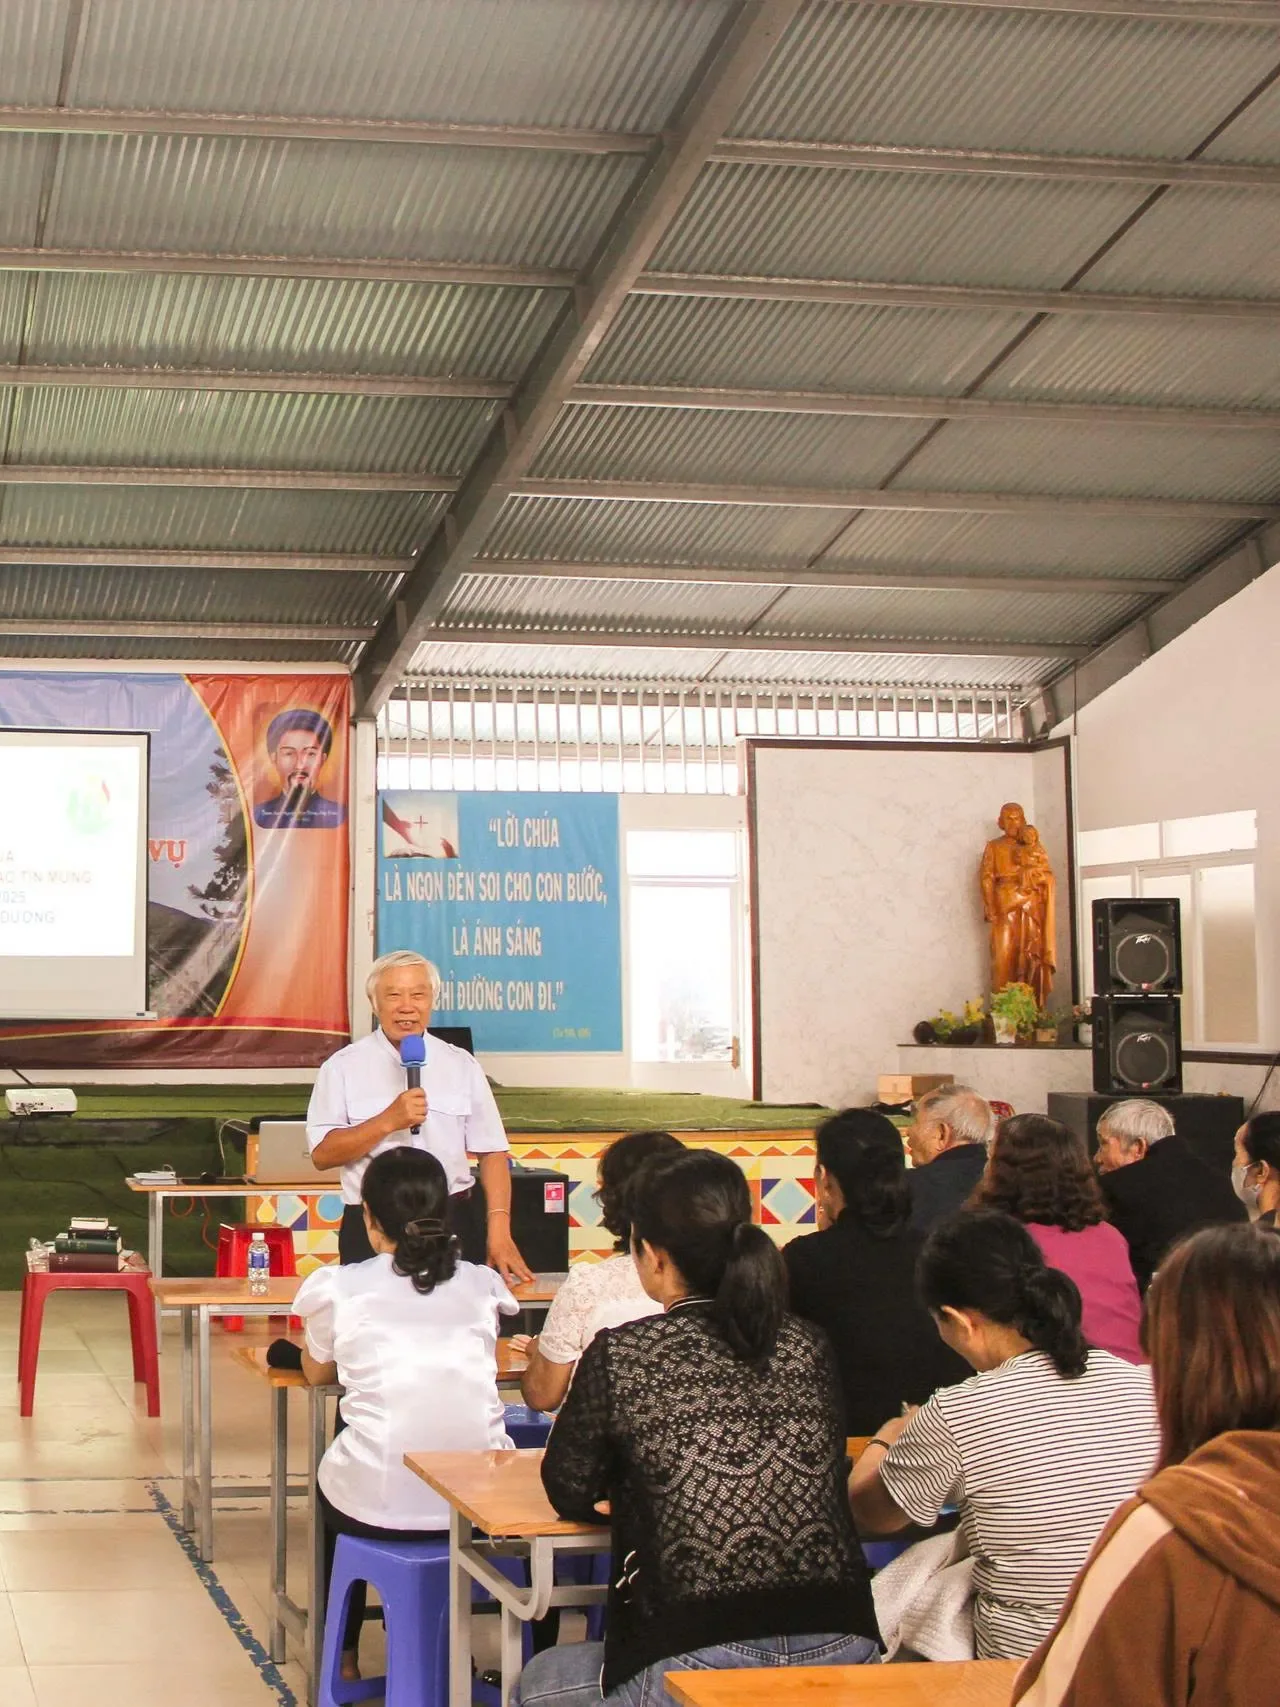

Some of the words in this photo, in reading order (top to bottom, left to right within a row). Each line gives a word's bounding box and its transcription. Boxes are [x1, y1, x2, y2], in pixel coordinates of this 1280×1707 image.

[523, 810, 559, 847] CHÚA
[384, 864, 402, 901] LÀ
[406, 871, 443, 908] NGỌN
[447, 864, 474, 901] ĐÈN
[479, 872, 500, 901] SOI
[505, 872, 532, 901] CHO
[536, 872, 562, 902] CON
[567, 865, 608, 908] BƯỚC,
[453, 918, 469, 956] LÀ
[474, 918, 501, 956] ÁNH
[506, 918, 542, 956] SÁNG
[457, 972, 503, 1011] ĐƯỜNG
[507, 981, 534, 1010] CON
